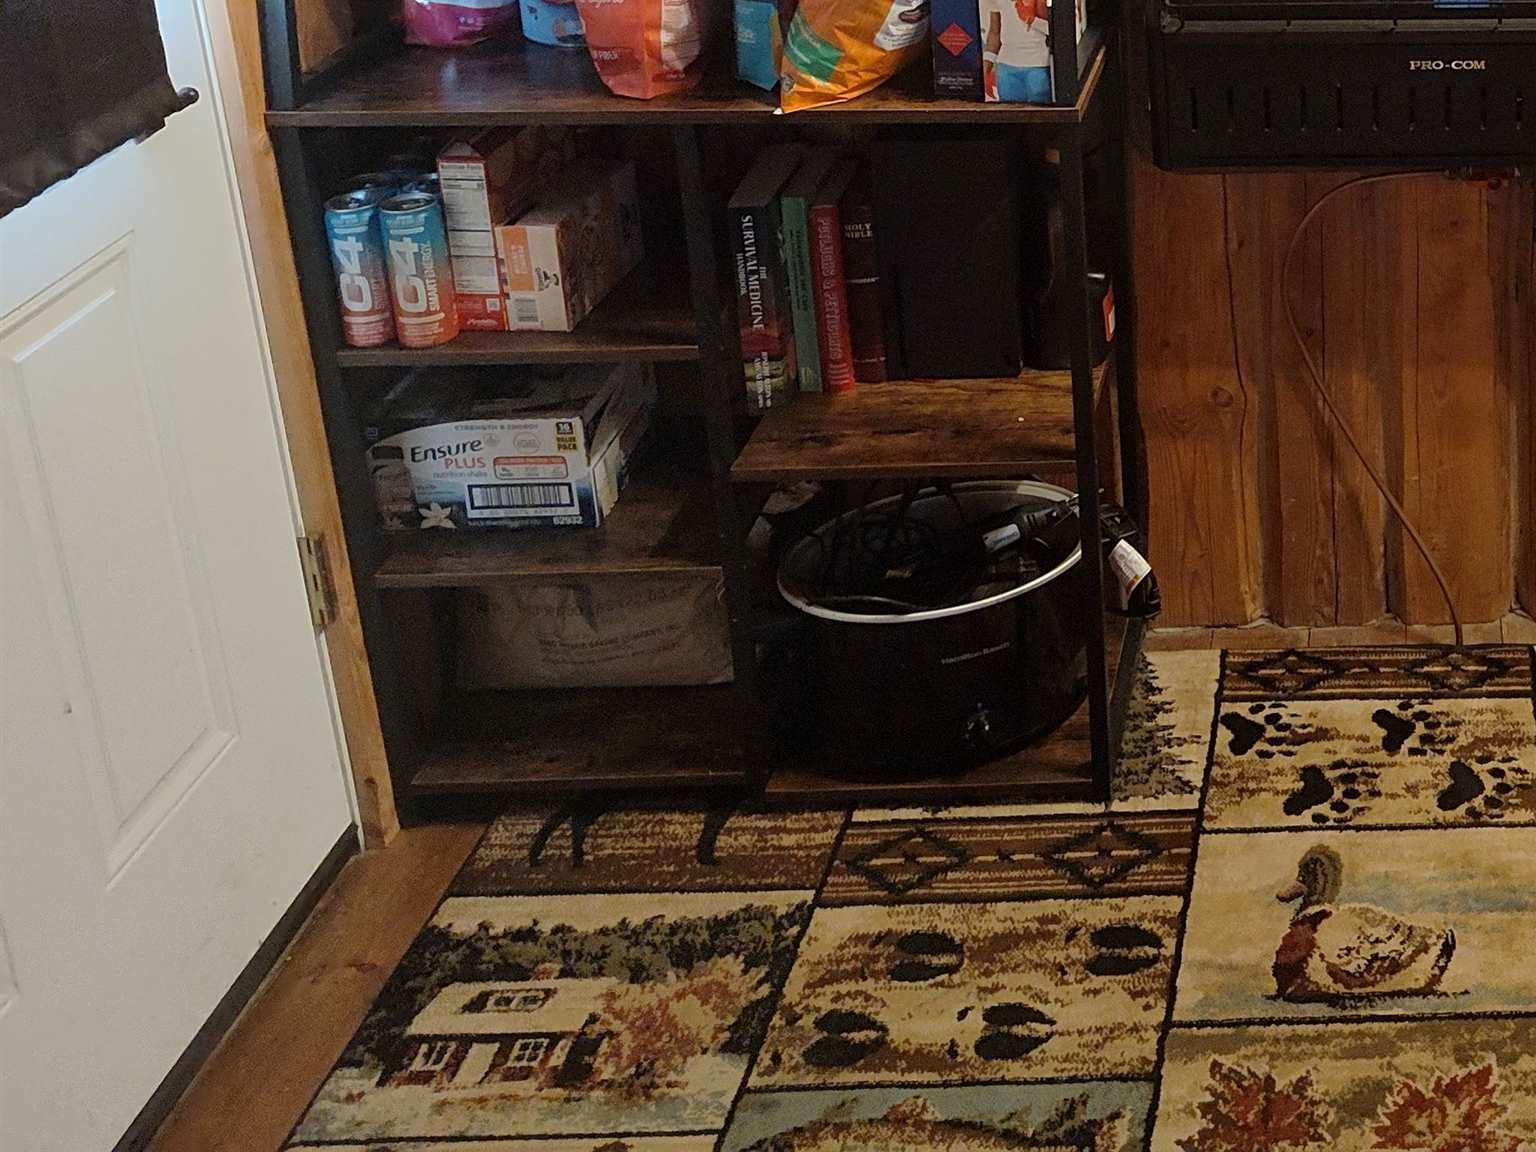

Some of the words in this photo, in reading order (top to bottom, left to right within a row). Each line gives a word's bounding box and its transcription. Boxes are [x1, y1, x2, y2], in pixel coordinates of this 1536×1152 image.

[1409, 60, 1486, 70] PRO-COM
[332, 236, 373, 312] C4
[389, 237, 428, 312] C4
[741, 214, 758, 270] SURVIVAL
[751, 272, 765, 331] MEDICINE
[411, 439, 483, 463] Ensure
[444, 457, 488, 469] PLUS
